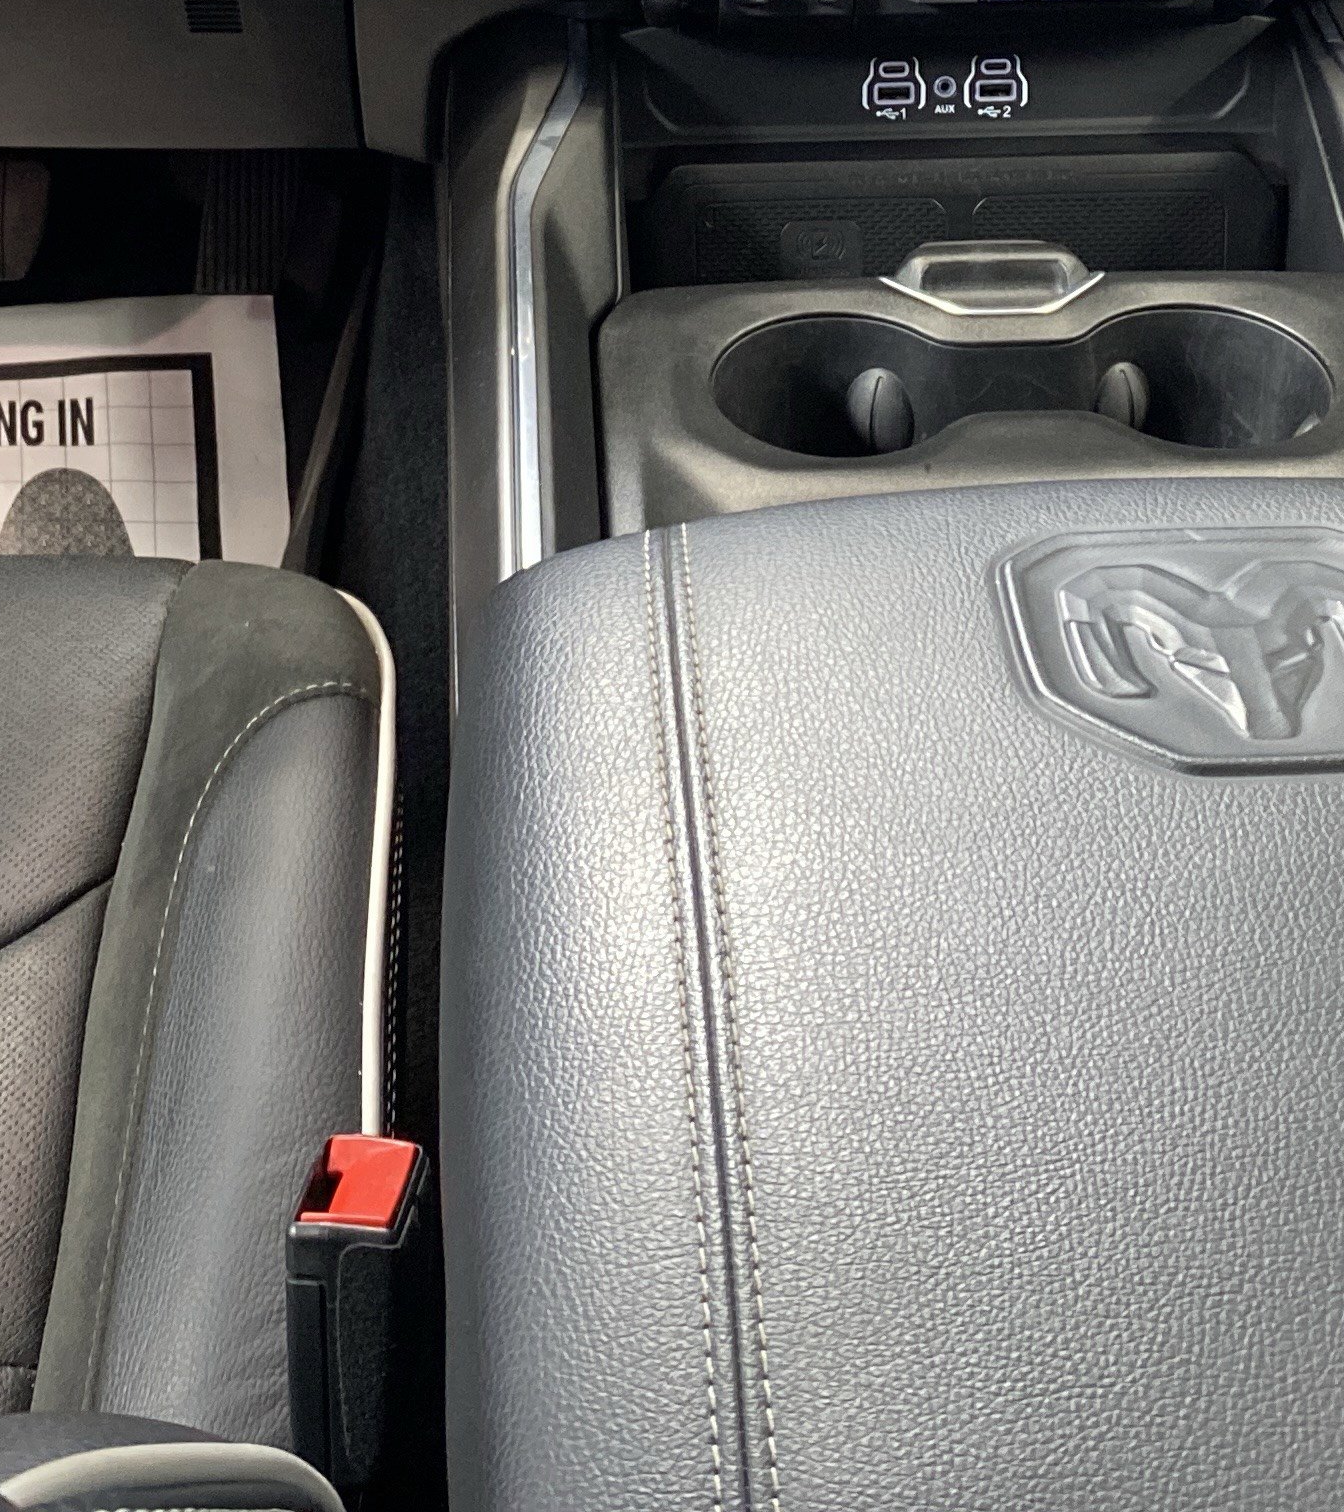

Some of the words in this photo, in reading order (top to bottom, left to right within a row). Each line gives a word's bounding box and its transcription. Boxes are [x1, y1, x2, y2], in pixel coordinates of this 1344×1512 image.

[900, 108, 907, 120] 1
[934, 104, 956, 114] AUX
[1003, 105, 1012, 118] 2
[56, 396, 95, 446] IN
